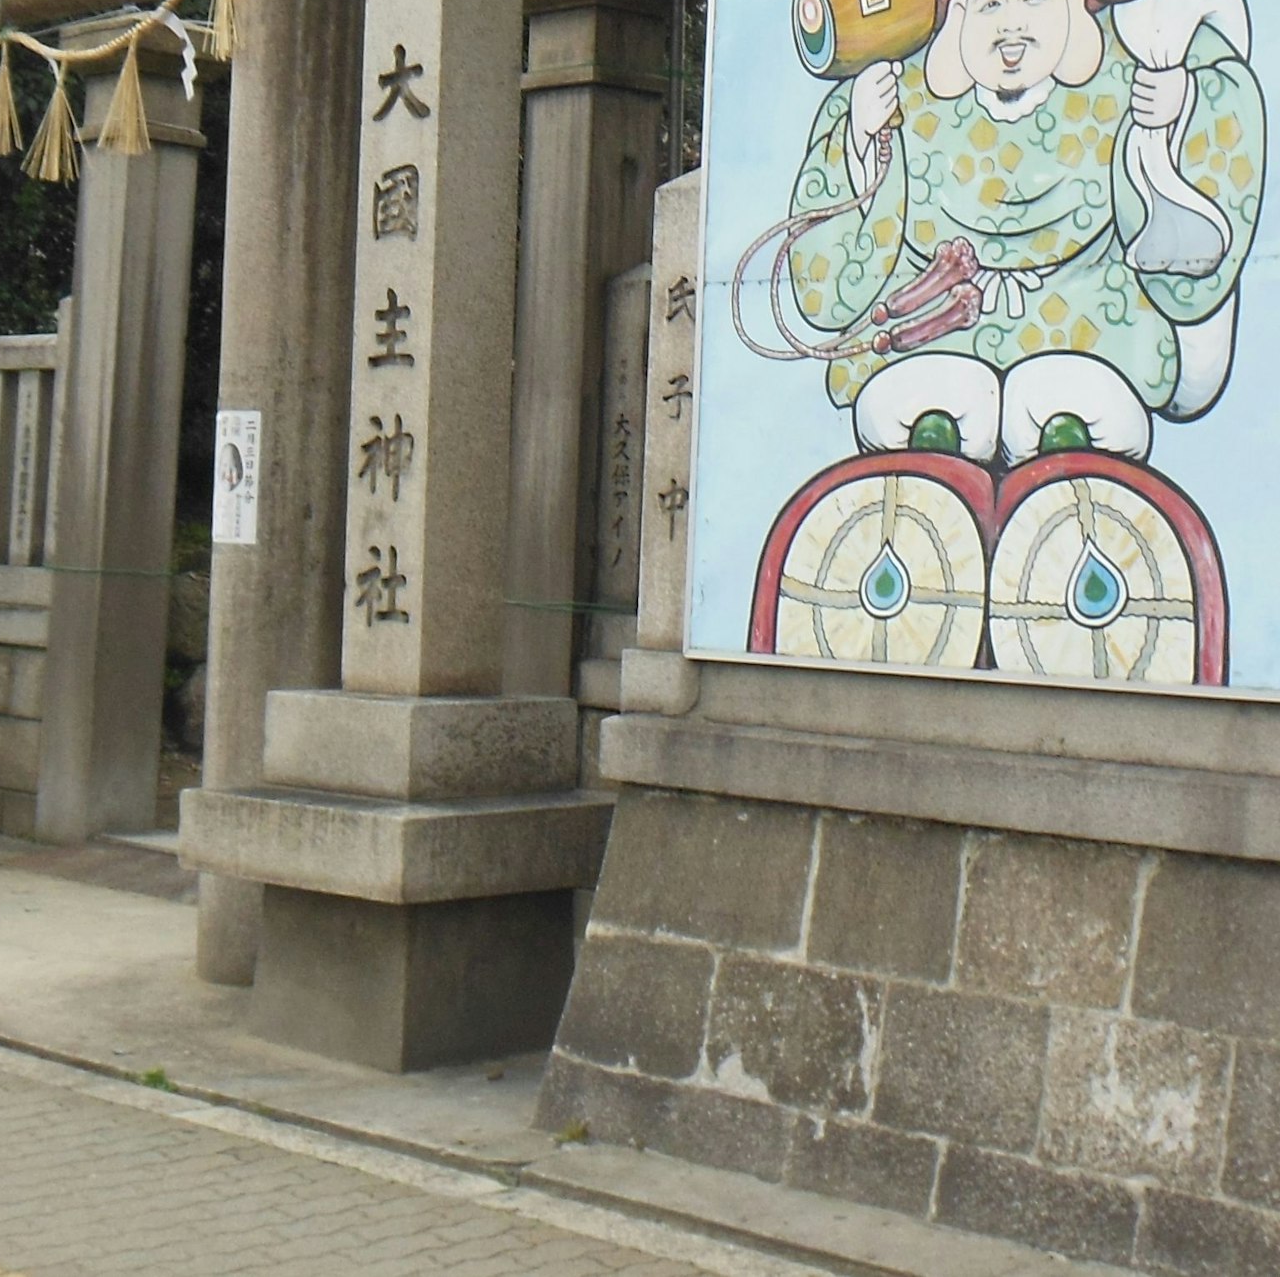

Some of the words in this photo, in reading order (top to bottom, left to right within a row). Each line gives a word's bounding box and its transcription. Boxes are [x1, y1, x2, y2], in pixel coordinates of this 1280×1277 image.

[354, 42, 432, 628] 大國主神社
